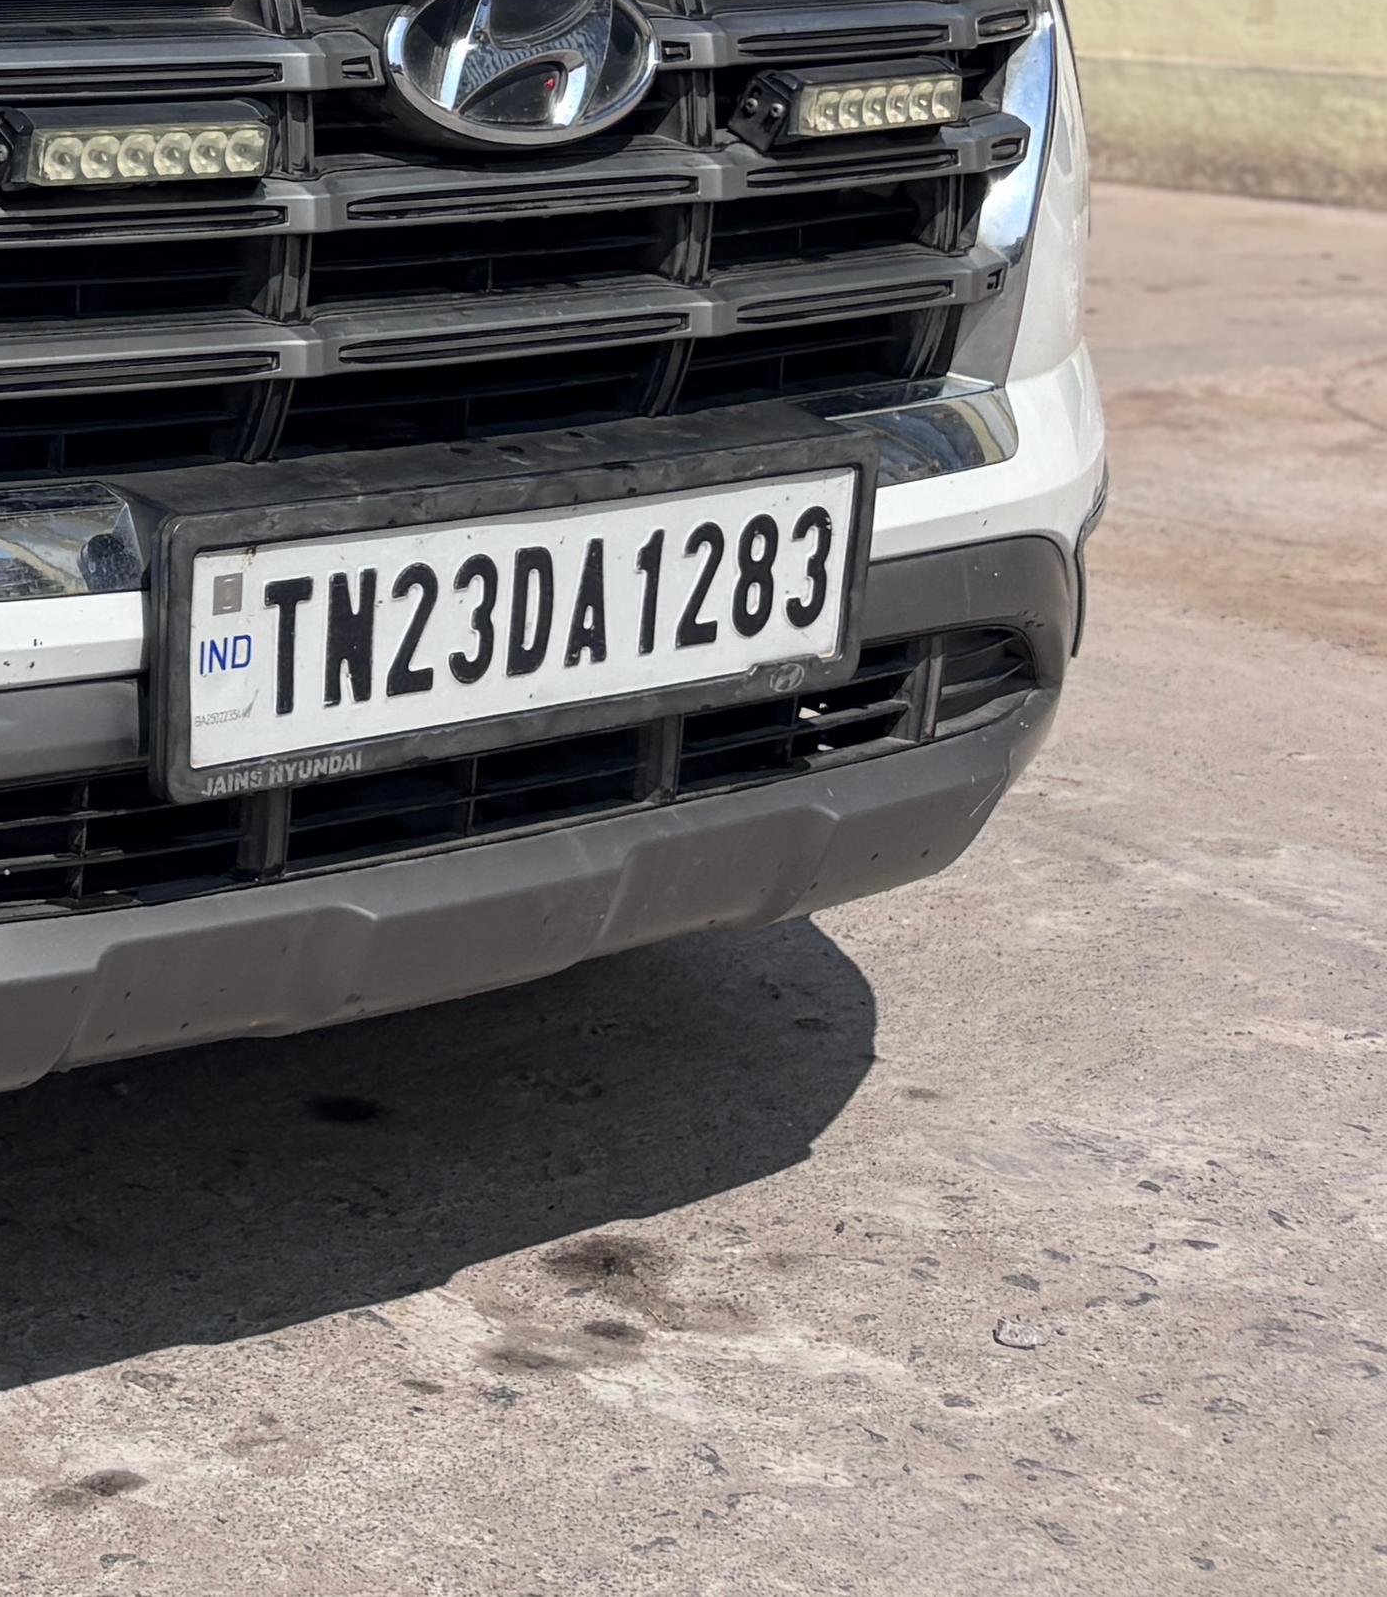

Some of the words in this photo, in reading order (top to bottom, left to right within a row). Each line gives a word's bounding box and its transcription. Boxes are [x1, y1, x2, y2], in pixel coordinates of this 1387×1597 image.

[264, 504, 832, 716] TN23DA1283
[199, 634, 252, 675] IND
[201, 769, 263, 797] JAINS
[268, 751, 363, 787] HYUNDAI
